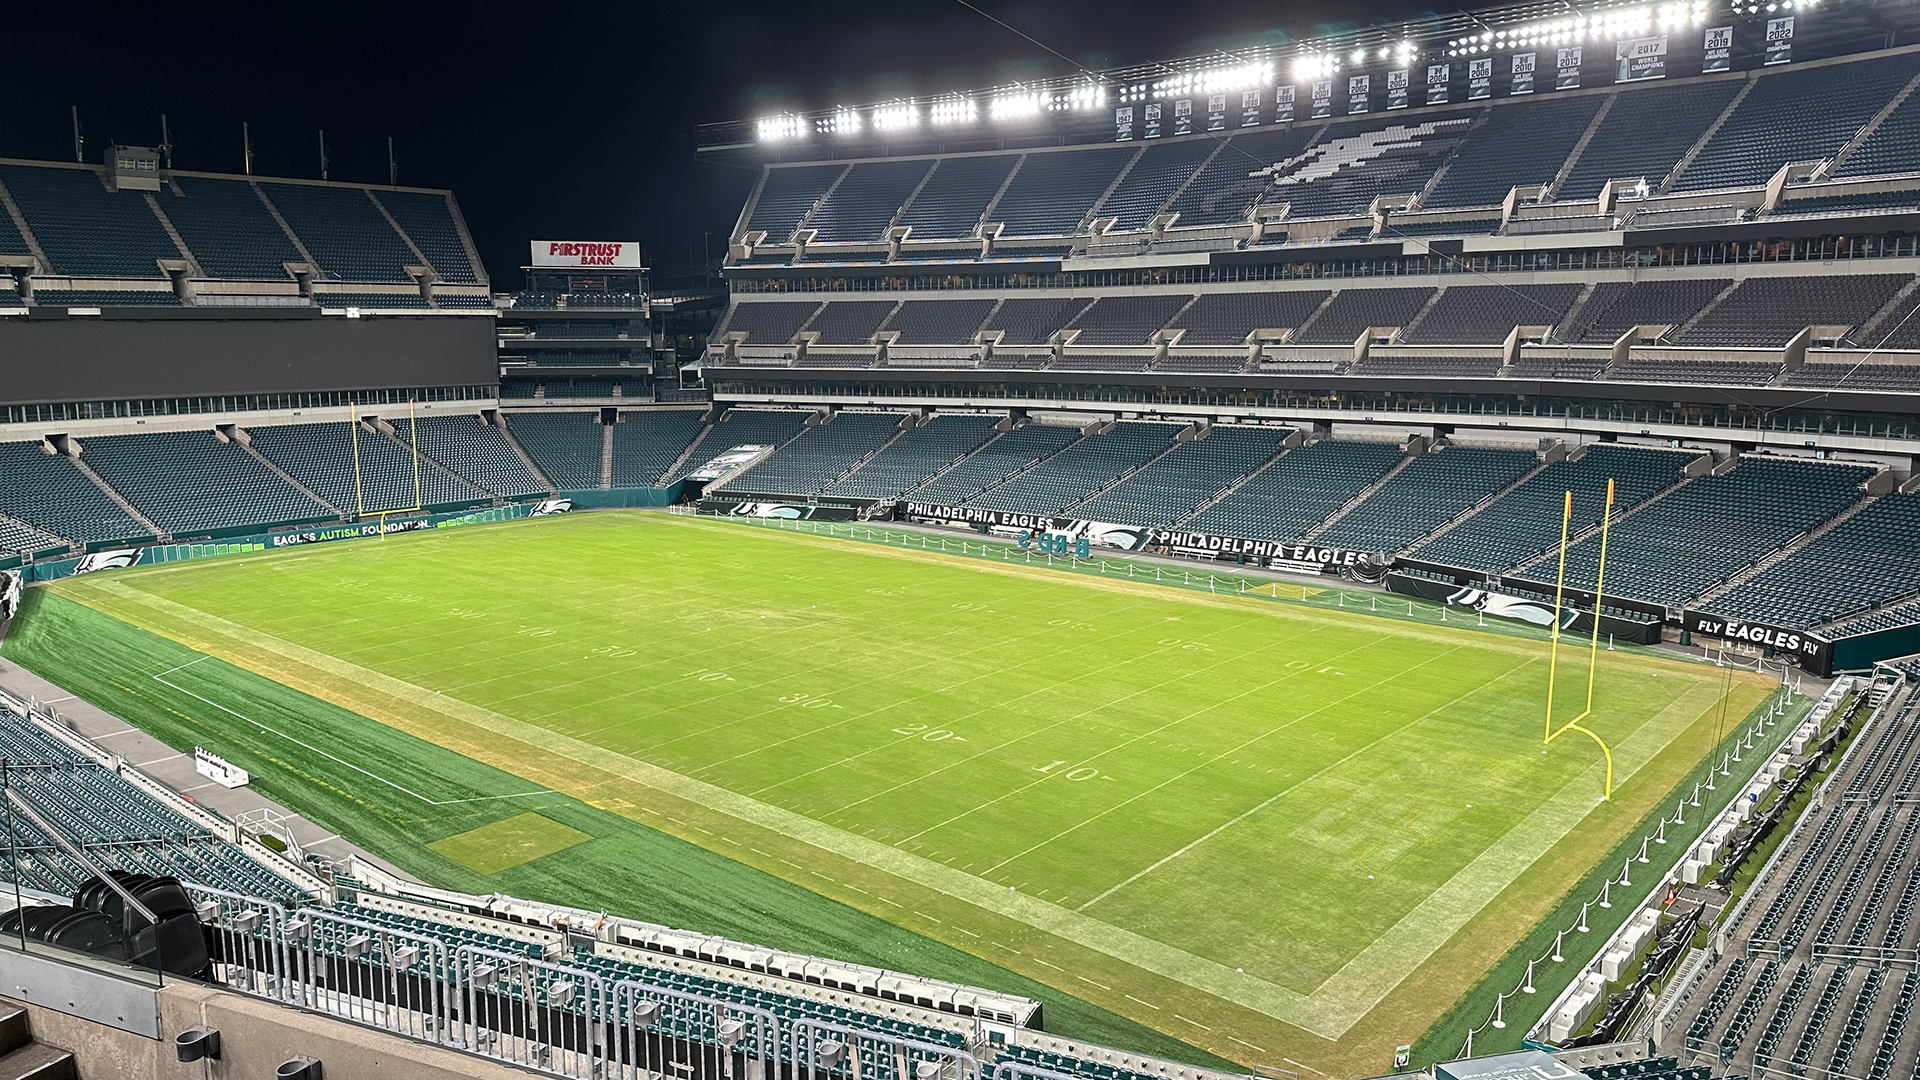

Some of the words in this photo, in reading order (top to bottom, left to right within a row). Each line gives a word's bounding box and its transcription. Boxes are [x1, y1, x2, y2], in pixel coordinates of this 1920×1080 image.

[1768, 29, 1791, 40] 2022
[1708, 38, 1729, 48] 2019
[1766, 44, 1791, 52] CHAMPIONS
[1637, 43, 1660, 54] 2017
[1637, 56, 1658, 64] WORLD
[1705, 52, 1730, 60] CHAMPIONS
[1560, 57, 1579, 66] 2013
[1631, 61, 1664, 71] CHAMPIONS
[1514, 63, 1532, 72] 2010
[1471, 68, 1490, 78] 2006
[1429, 74, 1447, 83] 2004
[580, 256, 615, 265] BANK
[907, 502, 996, 524] PHILADELPHIA
[1002, 513, 1054, 530] EAGLES
[273, 532, 316, 546] EAGLES
[319, 527, 360, 540] AUTISM
[1160, 531, 1284, 558] PHILADELPHIA
[1293, 546, 1369, 566] EAGLES
[1698, 620, 1722, 634] FLY
[1725, 622, 1800, 650] EAGLES
[1803, 640, 1819, 656] FLY
[778, 693, 833, 709] 30
[891, 722, 954, 742] 20
[1031, 760, 1099, 781] 10
